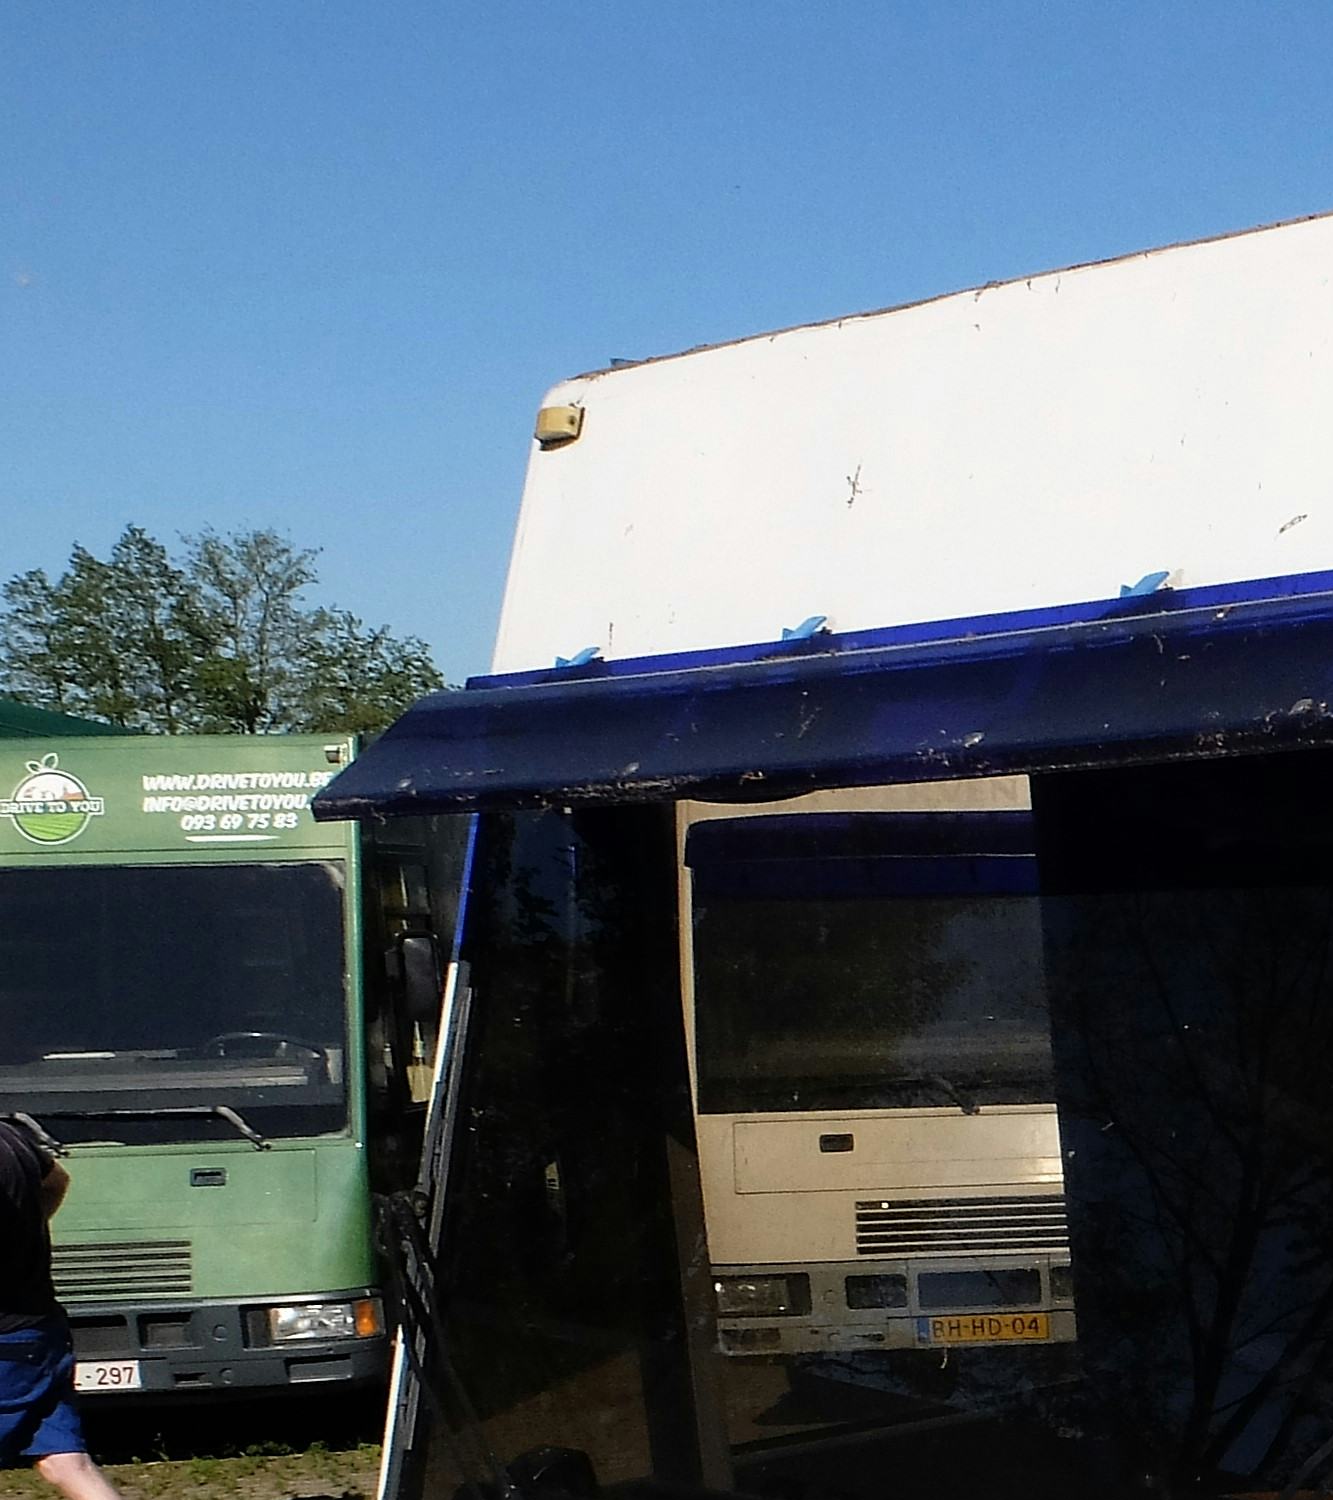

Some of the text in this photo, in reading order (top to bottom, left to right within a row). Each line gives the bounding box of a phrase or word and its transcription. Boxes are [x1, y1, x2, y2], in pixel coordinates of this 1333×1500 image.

[47, 801, 67, 813] TO
[70, 801, 100, 812] YOU
[181, 812, 299, 831] 093 69 75 83
[75, 1366, 135, 1387] -297
